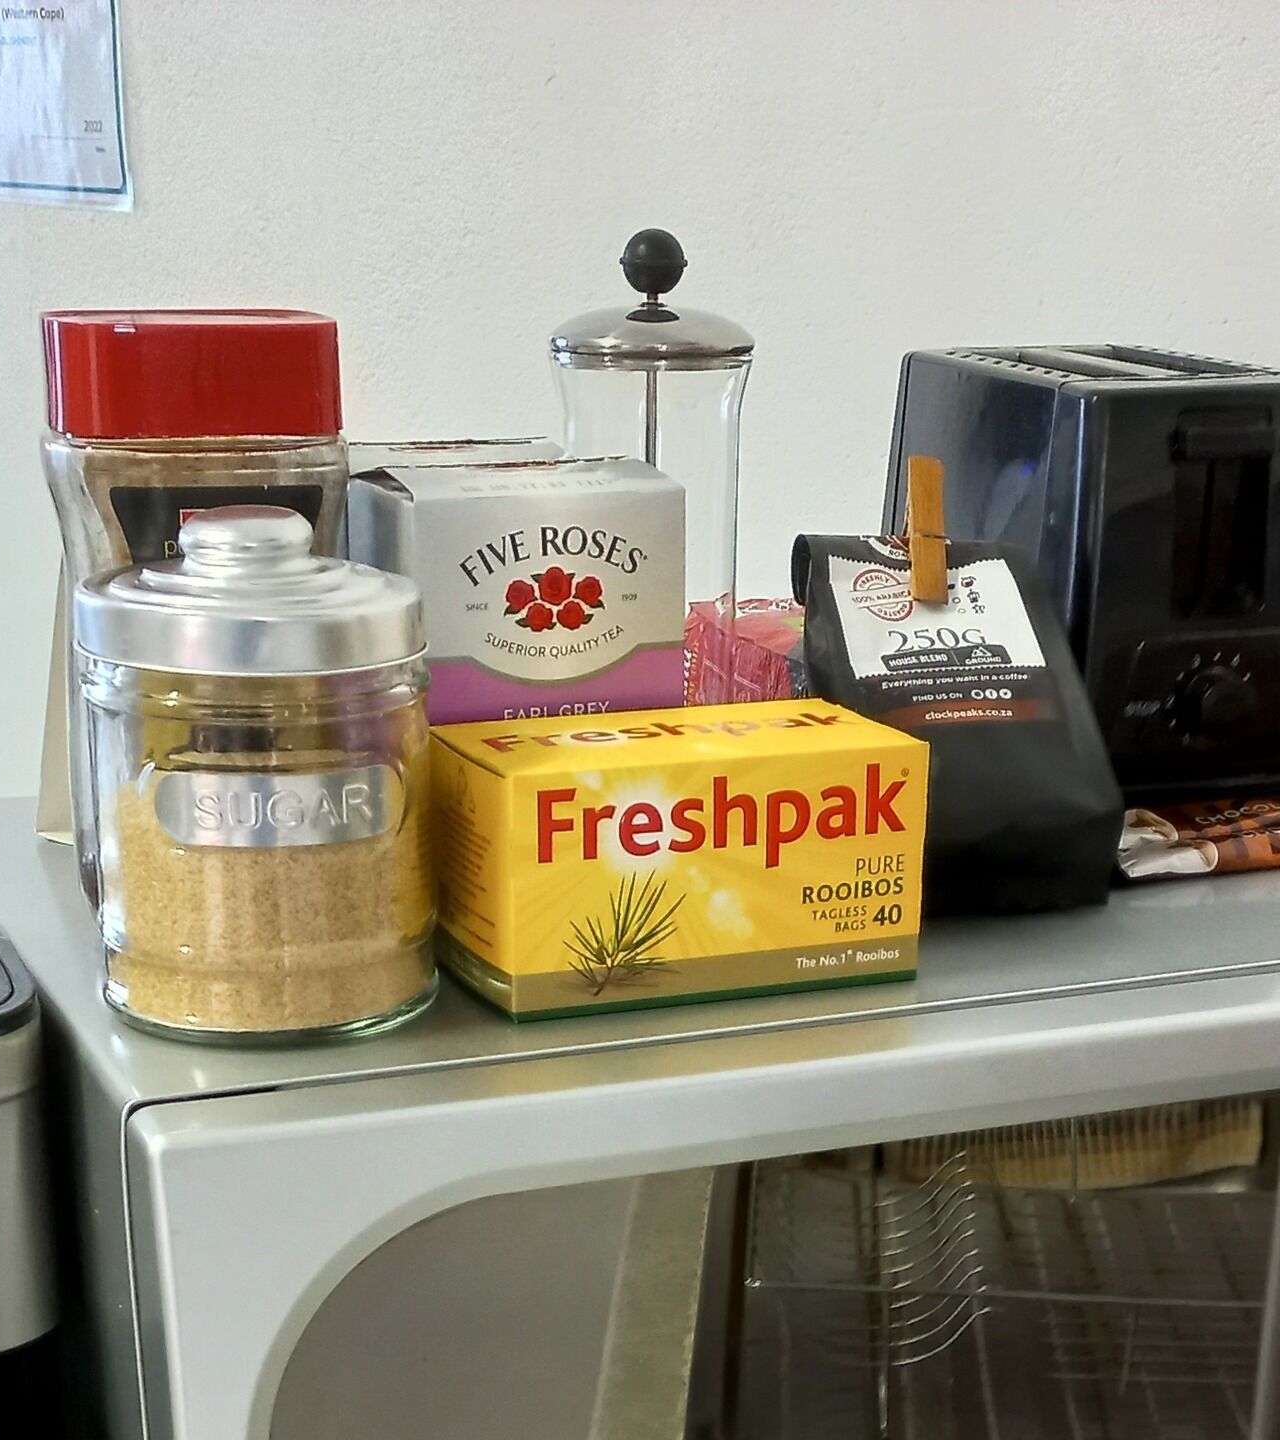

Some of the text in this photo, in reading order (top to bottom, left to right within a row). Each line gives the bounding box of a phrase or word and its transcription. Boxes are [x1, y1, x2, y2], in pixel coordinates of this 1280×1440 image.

[1, 8, 38, 22] (Western
[39, 7, 64, 23] Cape)
[83, 120, 103, 133] 2022
[459, 525, 644, 587] FIVE ROSES
[621, 593, 638, 601] 1909
[465, 602, 489, 611] SINCE
[484, 624, 625, 659] SUPERIOR QUALITY TEA
[887, 627, 988, 653] 250G
[888, 653, 948, 668] HOUSE BLEND
[965, 656, 1002, 665] GROUND
[881, 677, 934, 690] Everything
[935, 677, 954, 686] you
[955, 675, 978, 683] want
[998, 673, 1028, 681] coffee
[912, 694, 934, 702] FIND
[925, 709, 1013, 721] clockpeaks.co.za
[481, 711, 841, 754] Freshpak
[194, 783, 374, 831] SUGAR
[536, 762, 909, 869] Freshpak
[855, 853, 905, 877] PURE
[802, 876, 904, 905] ROOIBOS
[812, 903, 903, 927] TAGLESS 40
[834, 919, 867, 933] BAGS
[795, 957, 817, 969] The
[855, 949, 901, 963] Rooibos
